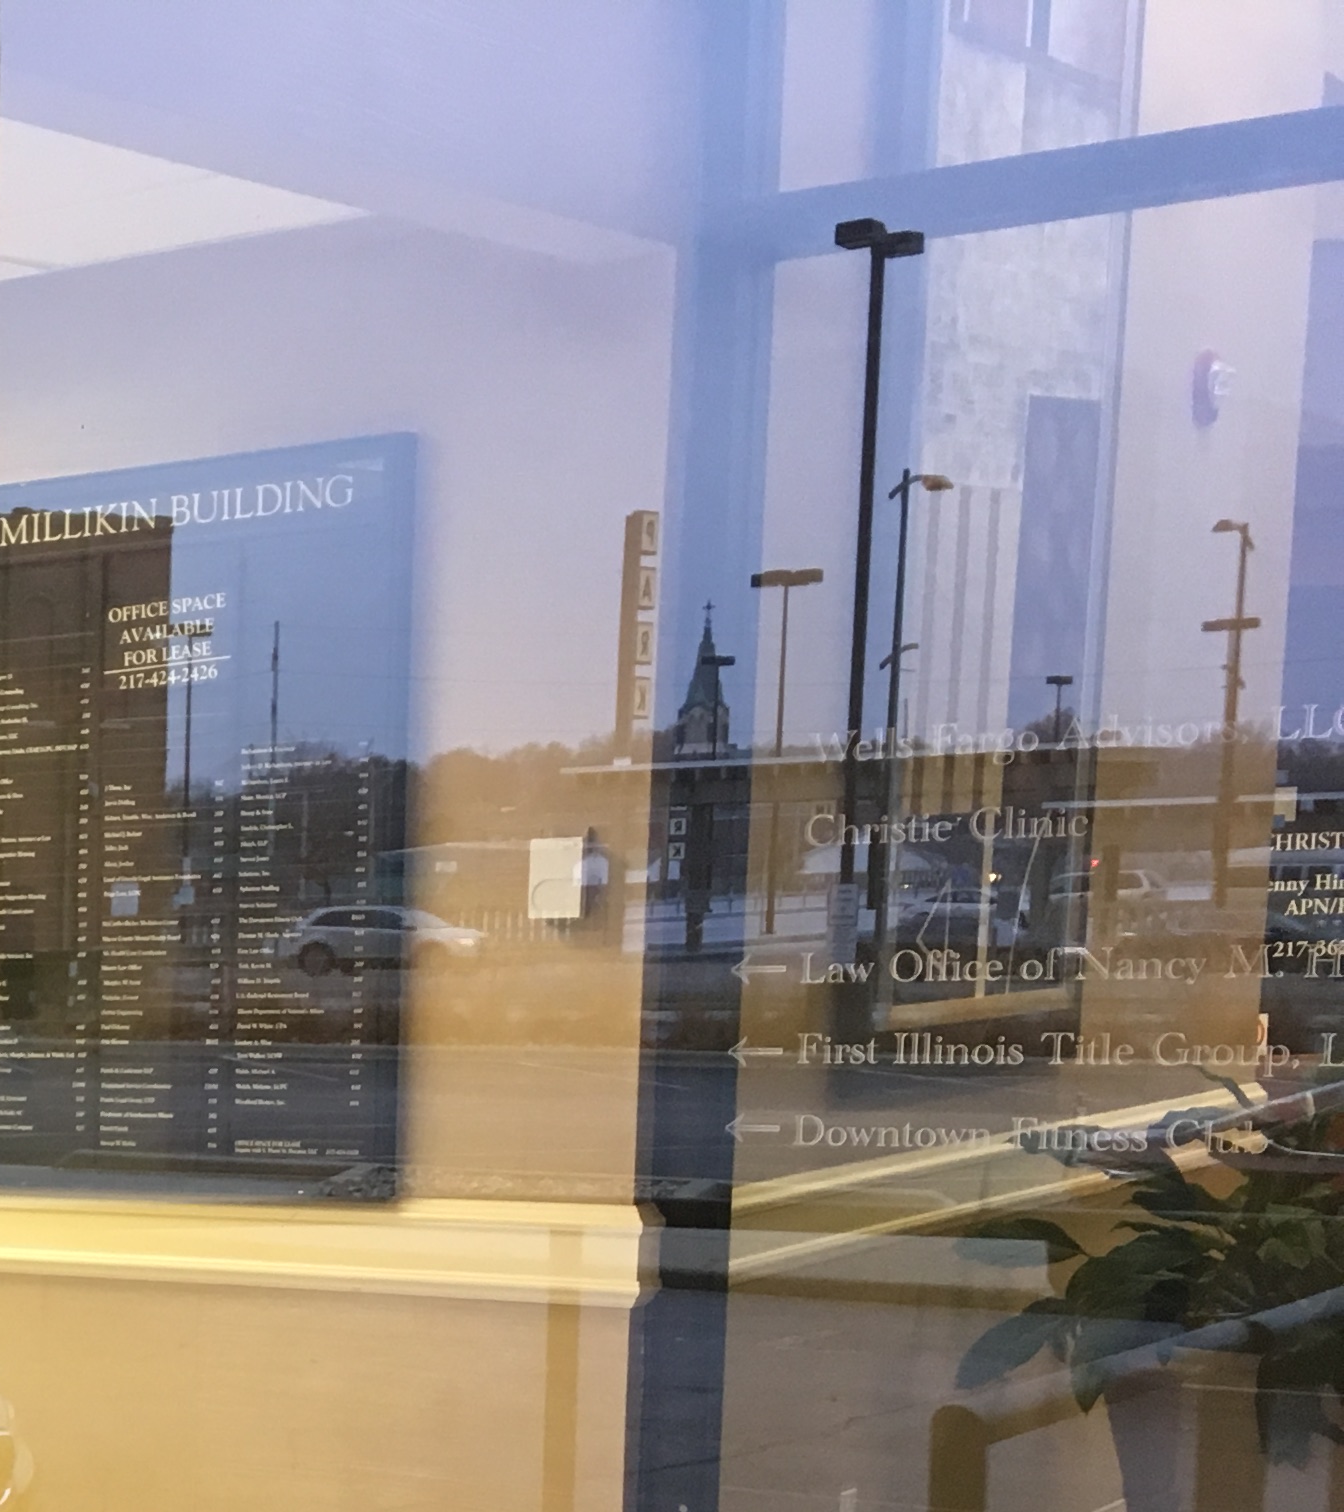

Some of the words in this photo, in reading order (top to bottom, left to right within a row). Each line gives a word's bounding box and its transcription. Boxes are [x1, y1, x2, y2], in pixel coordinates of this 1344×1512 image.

[0, 498, 158, 547] MILLIKIN
[170, 474, 355, 527] BUILDING
[108, 601, 168, 623] OFFICE
[171, 592, 227, 614] SPACE
[120, 618, 215, 645] AVAILABLE
[124, 647, 158, 667] FOR
[162, 641, 213, 662] LEASE
[118, 664, 218, 690] 217-424-2426
[811, 727, 913, 764] Wells
[931, 722, 1039, 765] Fargo
[1056, 713, 1249, 751] Advisors,
[804, 812, 953, 848] Christie
[969, 805, 1089, 842] Clinic
[1270, 831, 1344, 851] HRIST
[800, 951, 875, 985] Law
[889, 946, 1004, 983] Office
[1019, 946, 1065, 982] of
[1070, 946, 1207, 986] Nancy
[1223, 944, 1285, 979] M.
[797, 1031, 879, 1066] First
[892, 1031, 1025, 1066] Illinois
[1040, 1031, 1135, 1066] Title
[1153, 1031, 1301, 1078] Group,
[792, 1113, 991, 1149] Downtown
[1010, 1112, 1149, 1152] Fitness
[1165, 1118, 1270, 1155] Club
